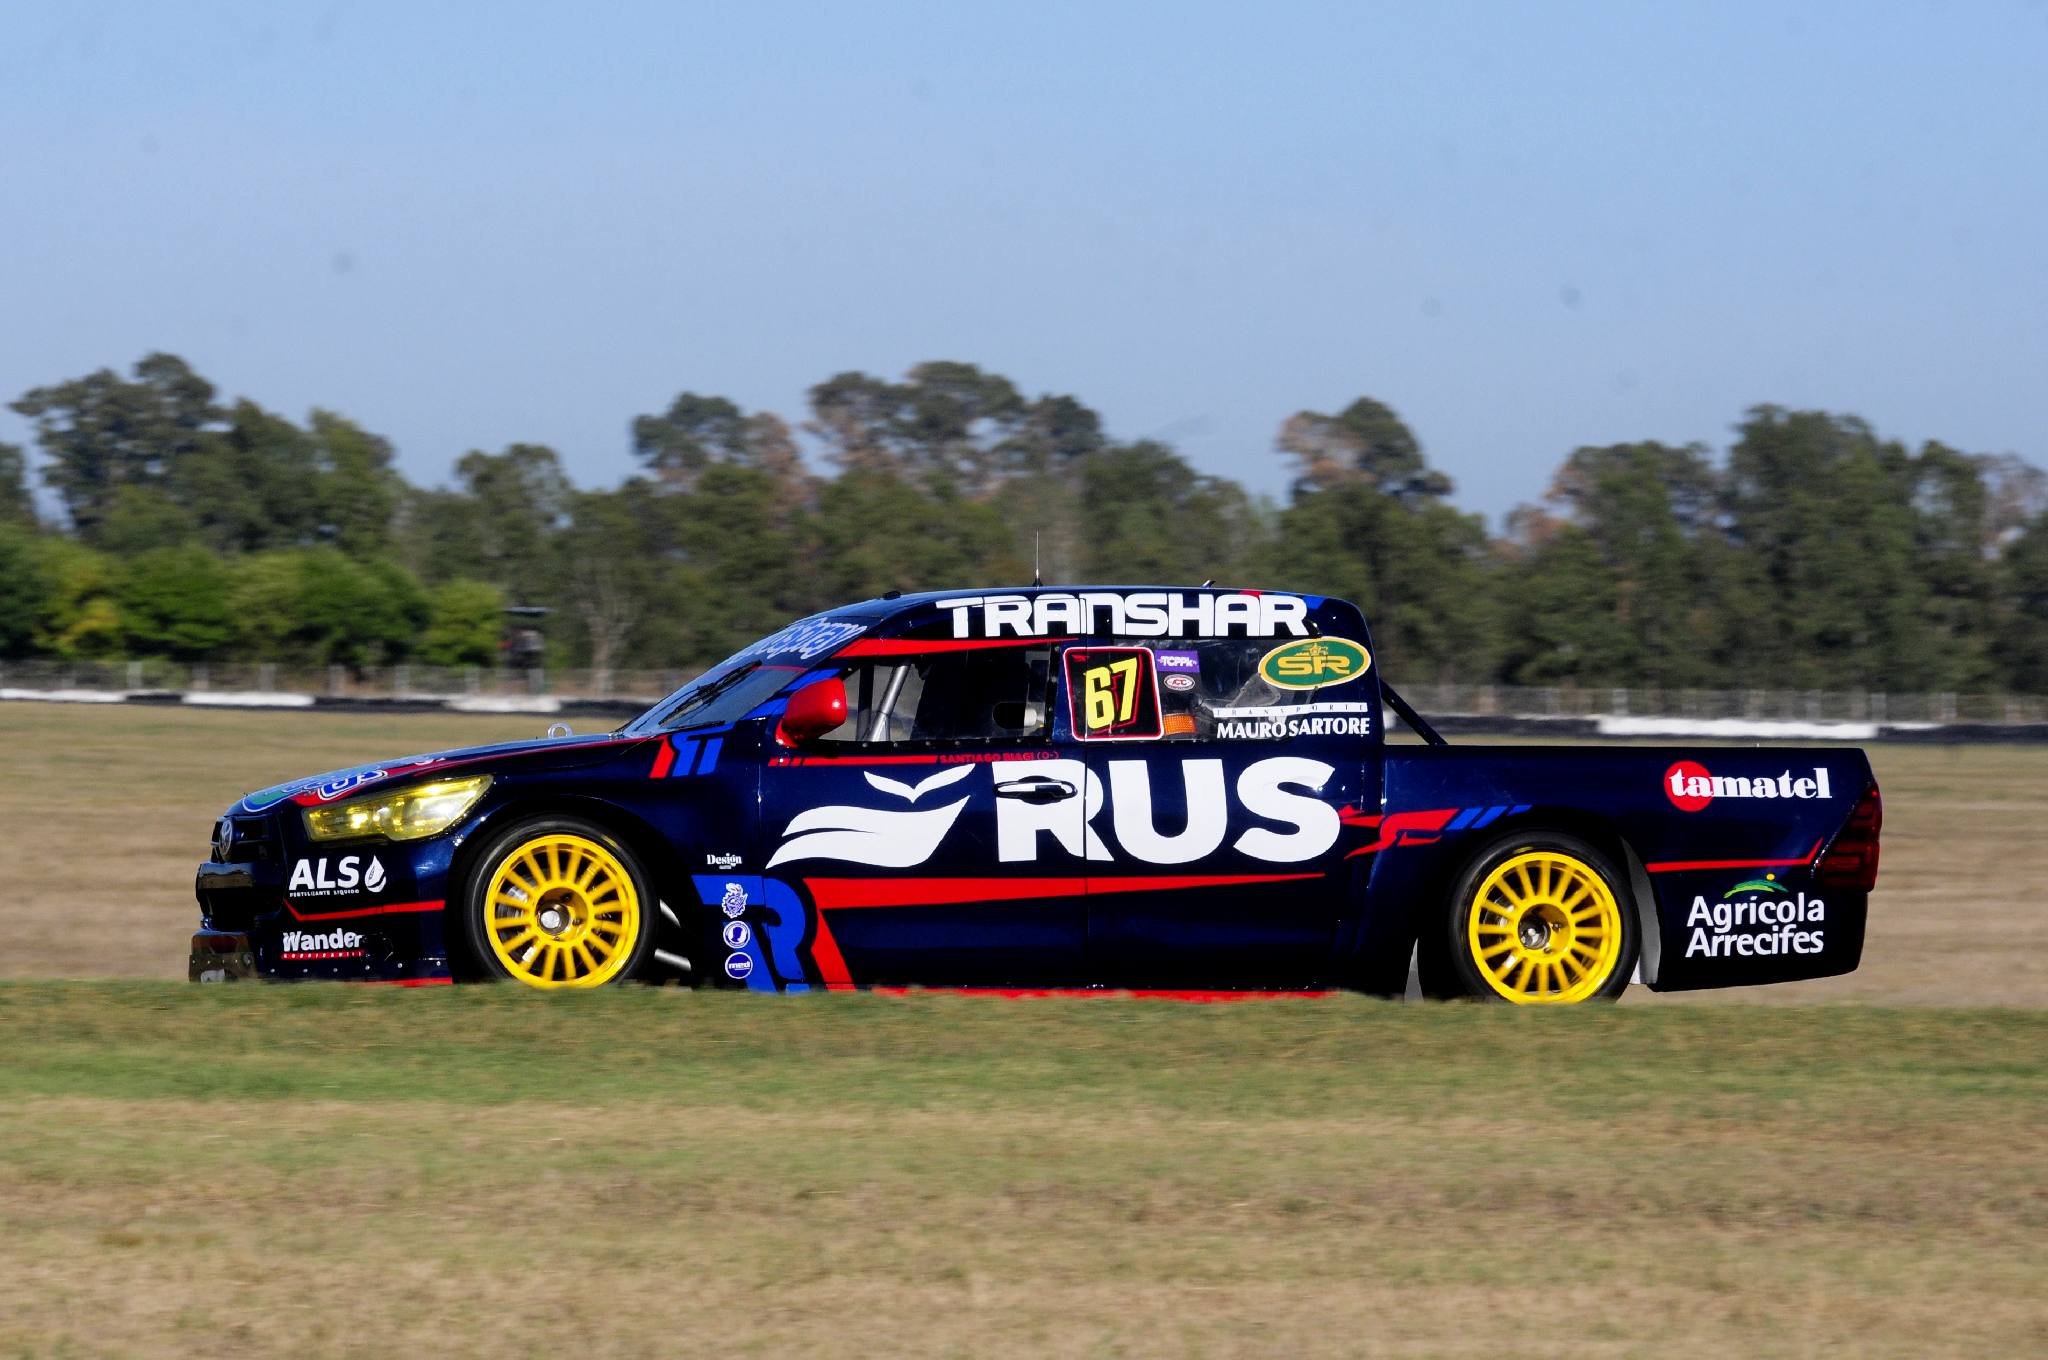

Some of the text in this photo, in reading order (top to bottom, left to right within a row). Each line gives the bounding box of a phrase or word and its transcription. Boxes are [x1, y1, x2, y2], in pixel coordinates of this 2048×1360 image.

[936, 593, 1308, 638] TRANSHAR
[1277, 655, 1350, 675] SR
[1084, 657, 1138, 729] 67
[1216, 717, 1371, 739] MAURO SARTORE
[940, 753, 1001, 763] SANTIAGO
[1669, 767, 1833, 799] tamatel
[991, 757, 1340, 864] RUS
[288, 856, 360, 890] ALS
[706, 852, 743, 867] Design
[282, 927, 363, 952] Wander
[1685, 924, 1825, 958] Arrecifes
